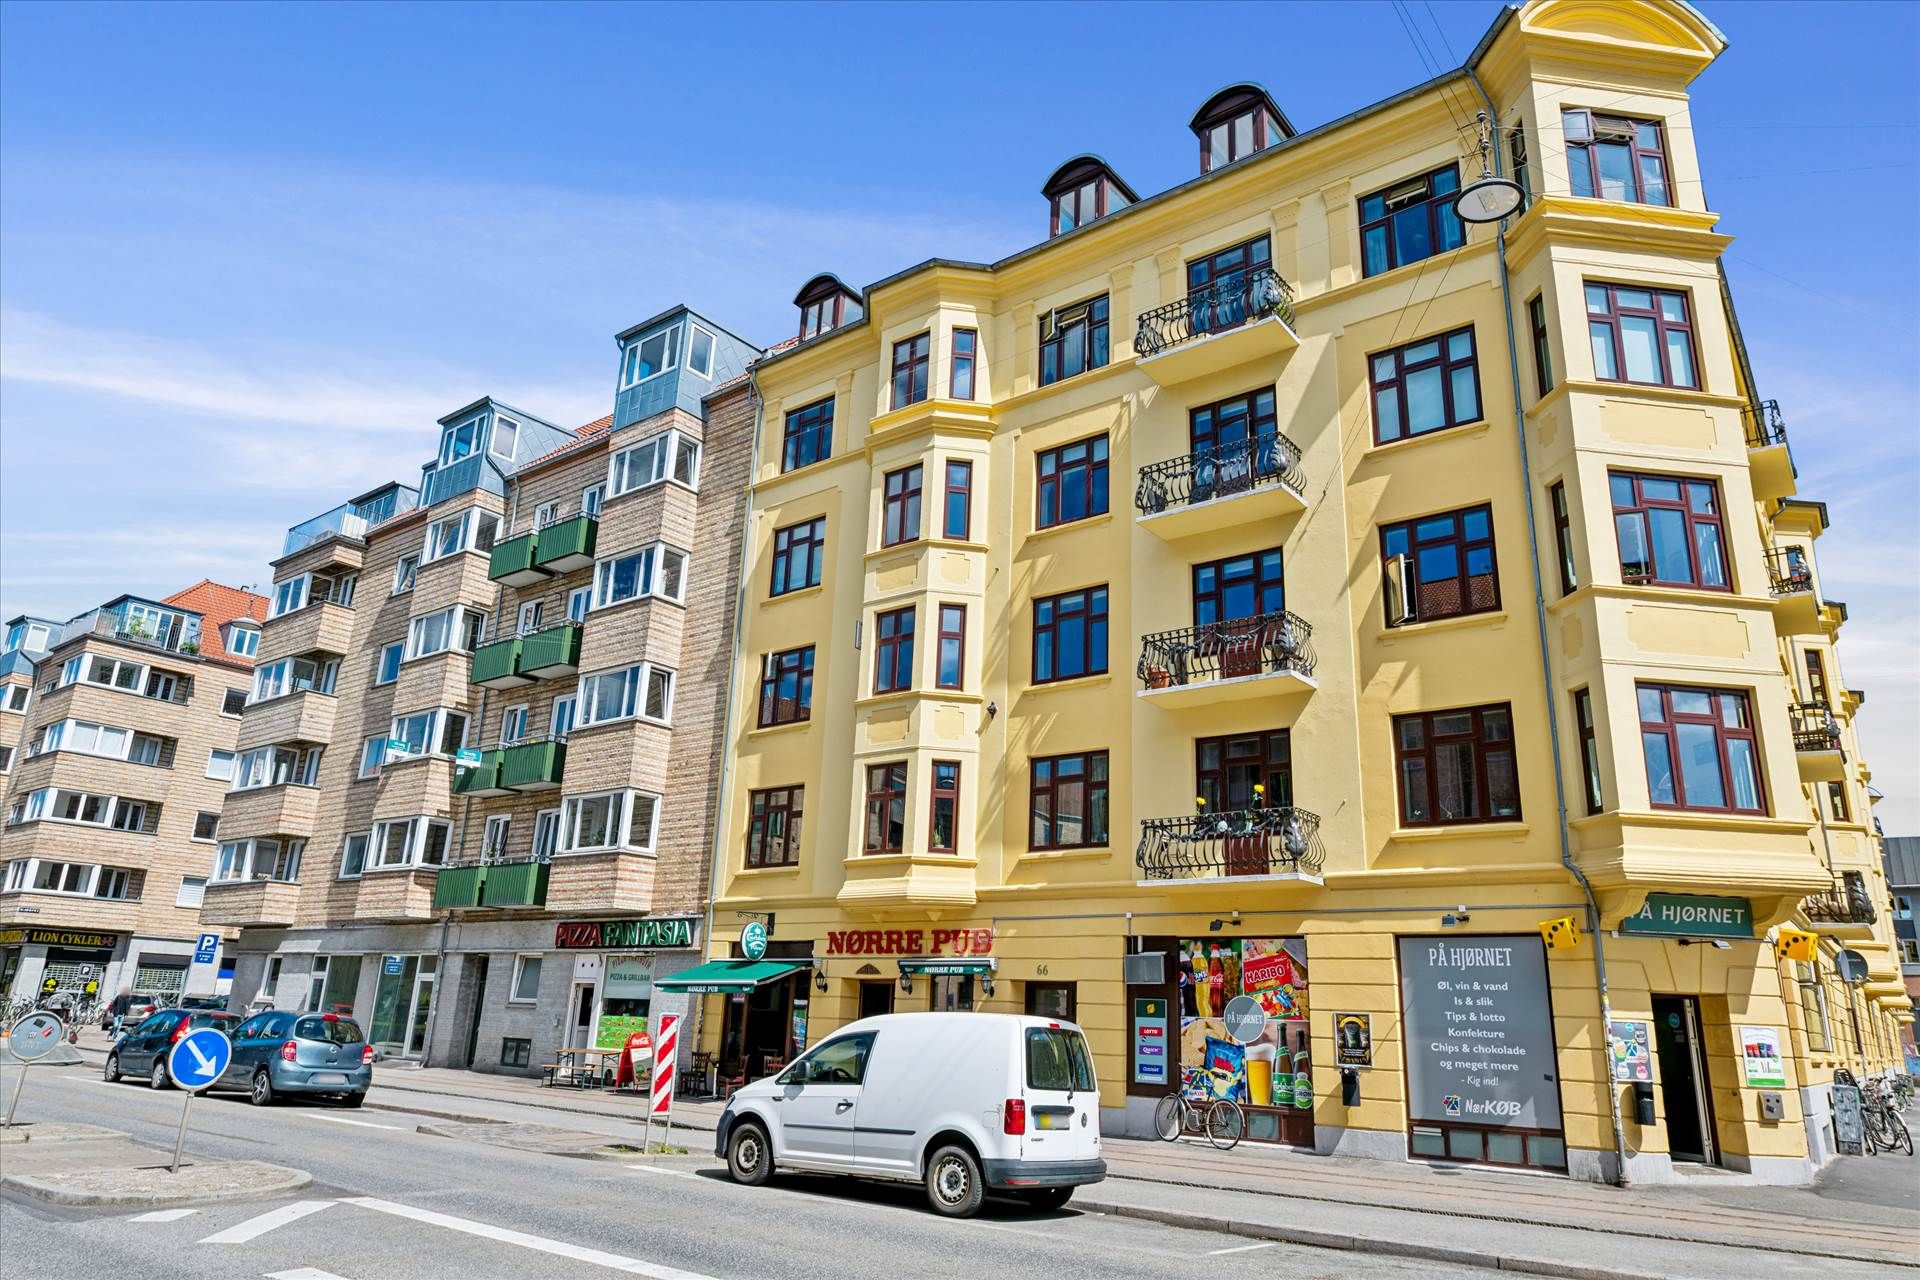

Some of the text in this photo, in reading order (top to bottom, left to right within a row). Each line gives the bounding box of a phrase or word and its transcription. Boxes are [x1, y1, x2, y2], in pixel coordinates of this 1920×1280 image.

[1630, 901, 1745, 924] Å HJØRNET
[32, 931, 59, 943] LION
[60, 933, 101, 946] CYKLER
[555, 920, 692, 947] PIZZA FANTASIA
[201, 936, 214, 951] P
[826, 928, 992, 956] NØRRE PUB
[1429, 943, 1512, 970] PÅ HJØRNET
[82, 966, 90, 974] P
[924, 966, 948, 974] NØRRE
[949, 966, 964, 974] PUB
[1036, 964, 1049, 976] 66
[1245, 965, 1286, 984] HARIBO
[610, 973, 623, 981] PIZZA
[687, 985, 706, 993] NØRRE
[1437, 981, 1508, 991] Øl, vin & vand
[1454, 996, 1494, 1006] Is & slik
[1227, 1011, 1263, 1026] PÅ HJØRNET
[1444, 1012, 1506, 1022] Tips & lotto
[1448, 1028, 1505, 1038] Konfekture
[1431, 1042, 1526, 1055] Chips & chokolade
[1440, 1060, 1519, 1071] og meget mere
[1467, 1075, 1481, 1087] Kig
[1483, 1076, 1499, 1086] ind!
[1465, 1099, 1521, 1116] NærKØB
